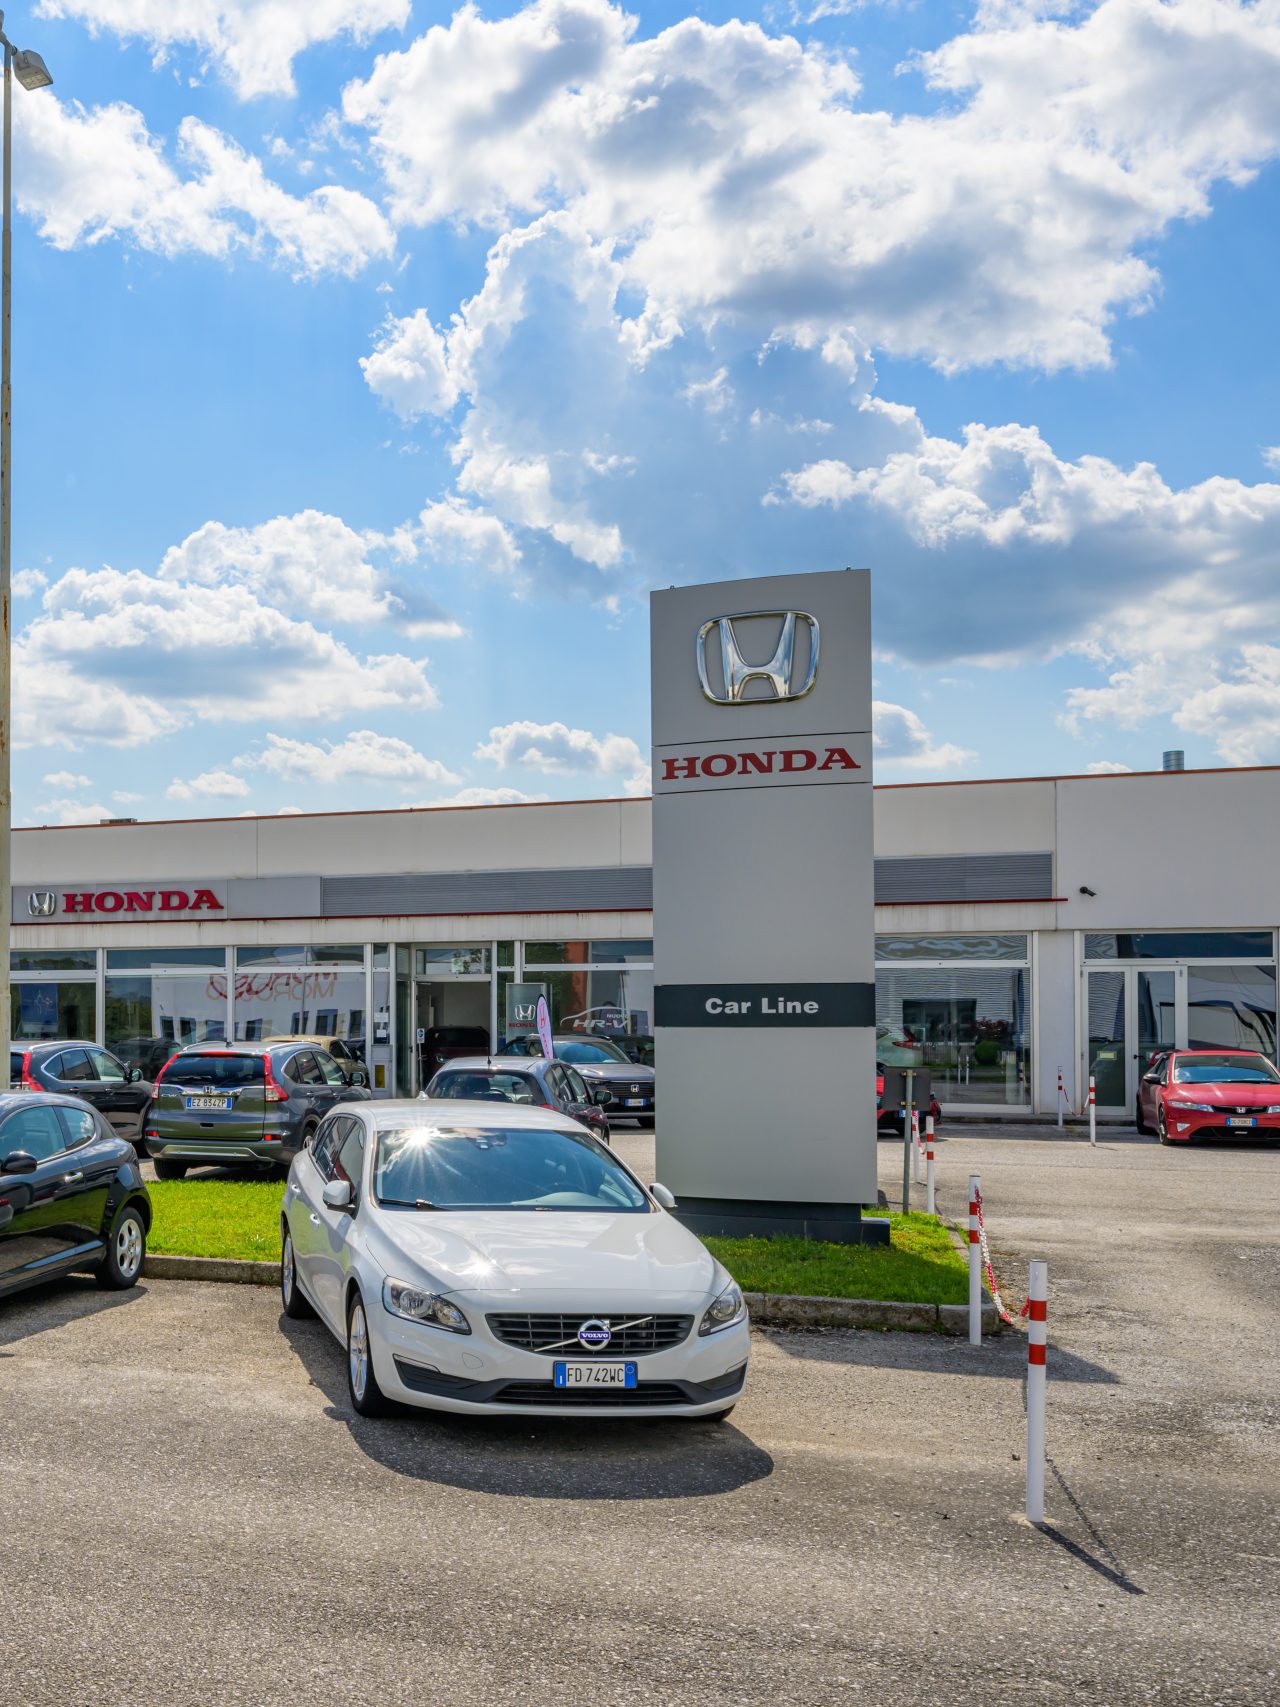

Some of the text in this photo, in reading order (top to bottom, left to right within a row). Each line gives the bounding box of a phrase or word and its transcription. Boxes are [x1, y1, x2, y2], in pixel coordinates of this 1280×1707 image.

[661, 747, 862, 781] HONDA
[62, 889, 225, 913] HONDA
[705, 997, 819, 1015] Car Line
[567, 1368, 624, 1383] FD 742WC
